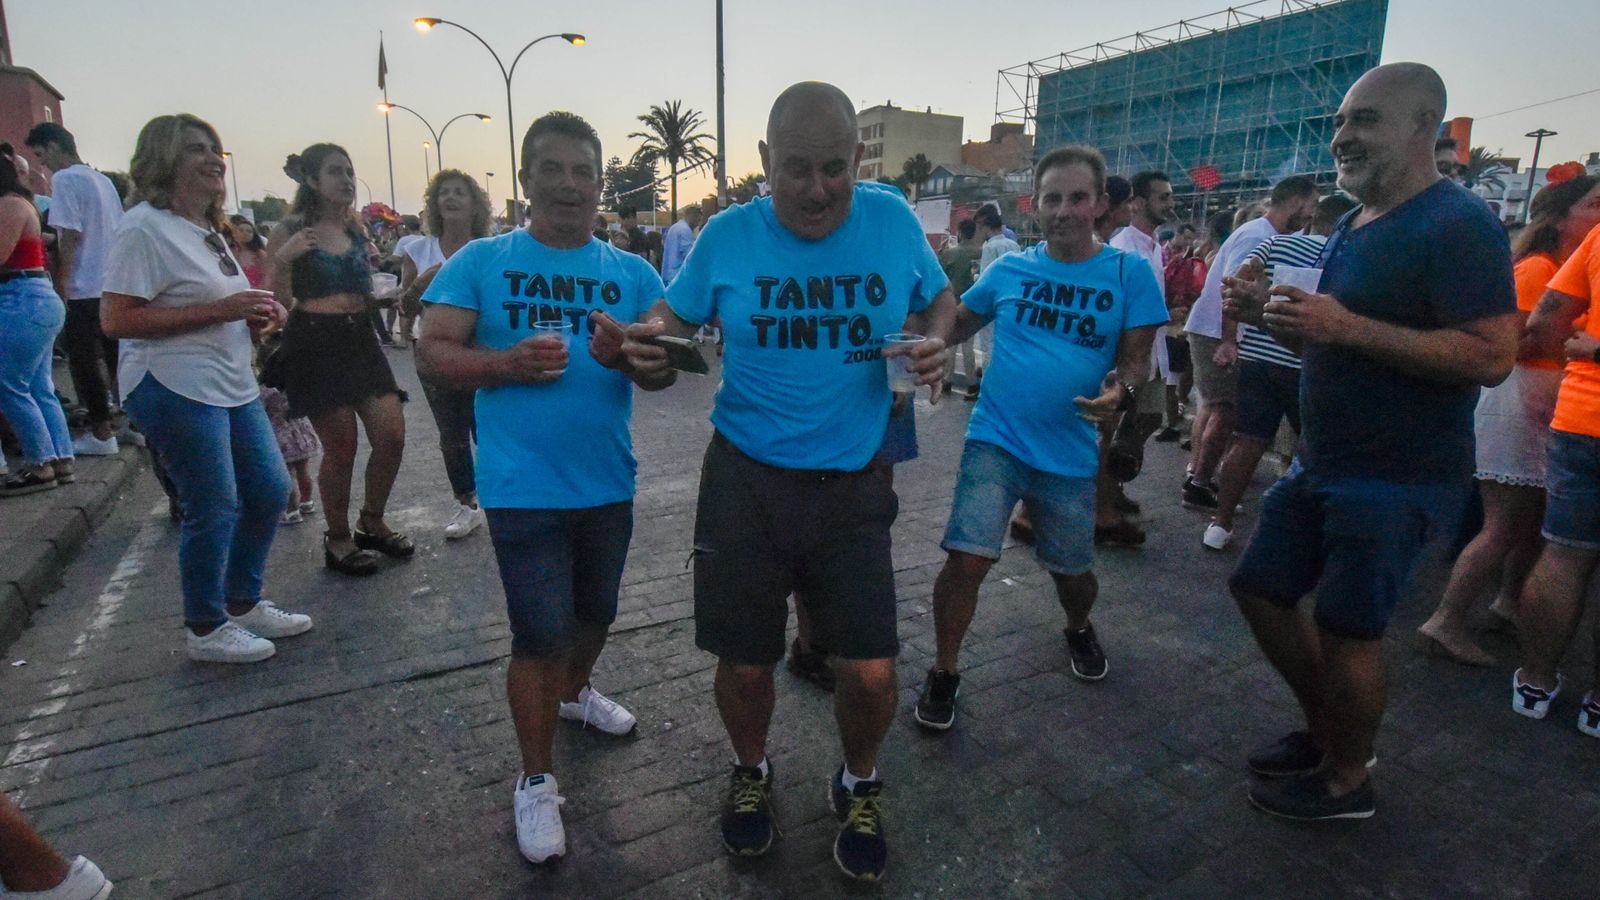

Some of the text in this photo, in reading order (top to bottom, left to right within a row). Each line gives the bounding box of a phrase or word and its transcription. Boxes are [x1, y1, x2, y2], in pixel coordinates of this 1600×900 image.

[504, 270, 621, 305] TANTO
[754, 273, 886, 309] TANTO
[1021, 280, 1113, 312] TANTO
[751, 314, 871, 349] TINTO
[1015, 300, 1096, 336] TINTO
